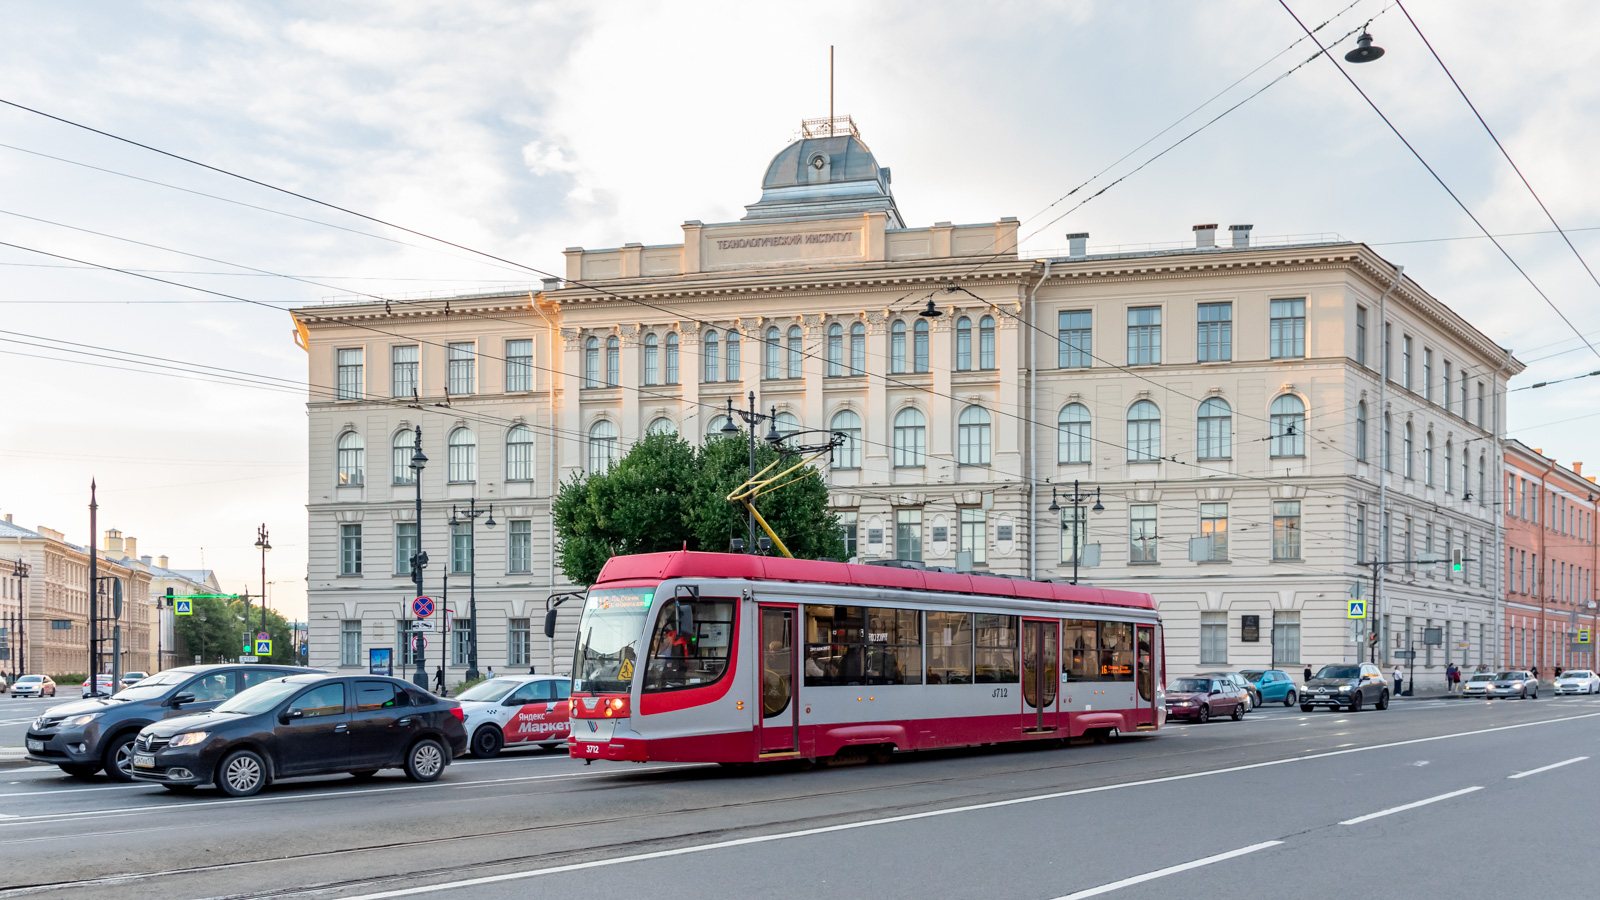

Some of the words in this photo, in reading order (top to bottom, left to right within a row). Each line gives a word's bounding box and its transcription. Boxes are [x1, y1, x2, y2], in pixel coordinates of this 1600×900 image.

[716, 235, 802, 250] ТЕХНОЛОГИЧЕСКИЙ
[805, 232, 853, 245] ИНСТИТУТ
[1101, 665, 1108, 674] 16
[991, 687, 1008, 698] 3712
[518, 713, 545, 721] Яндекс
[518, 721, 570, 733] Маркет
[586, 745, 599, 754] 3712
